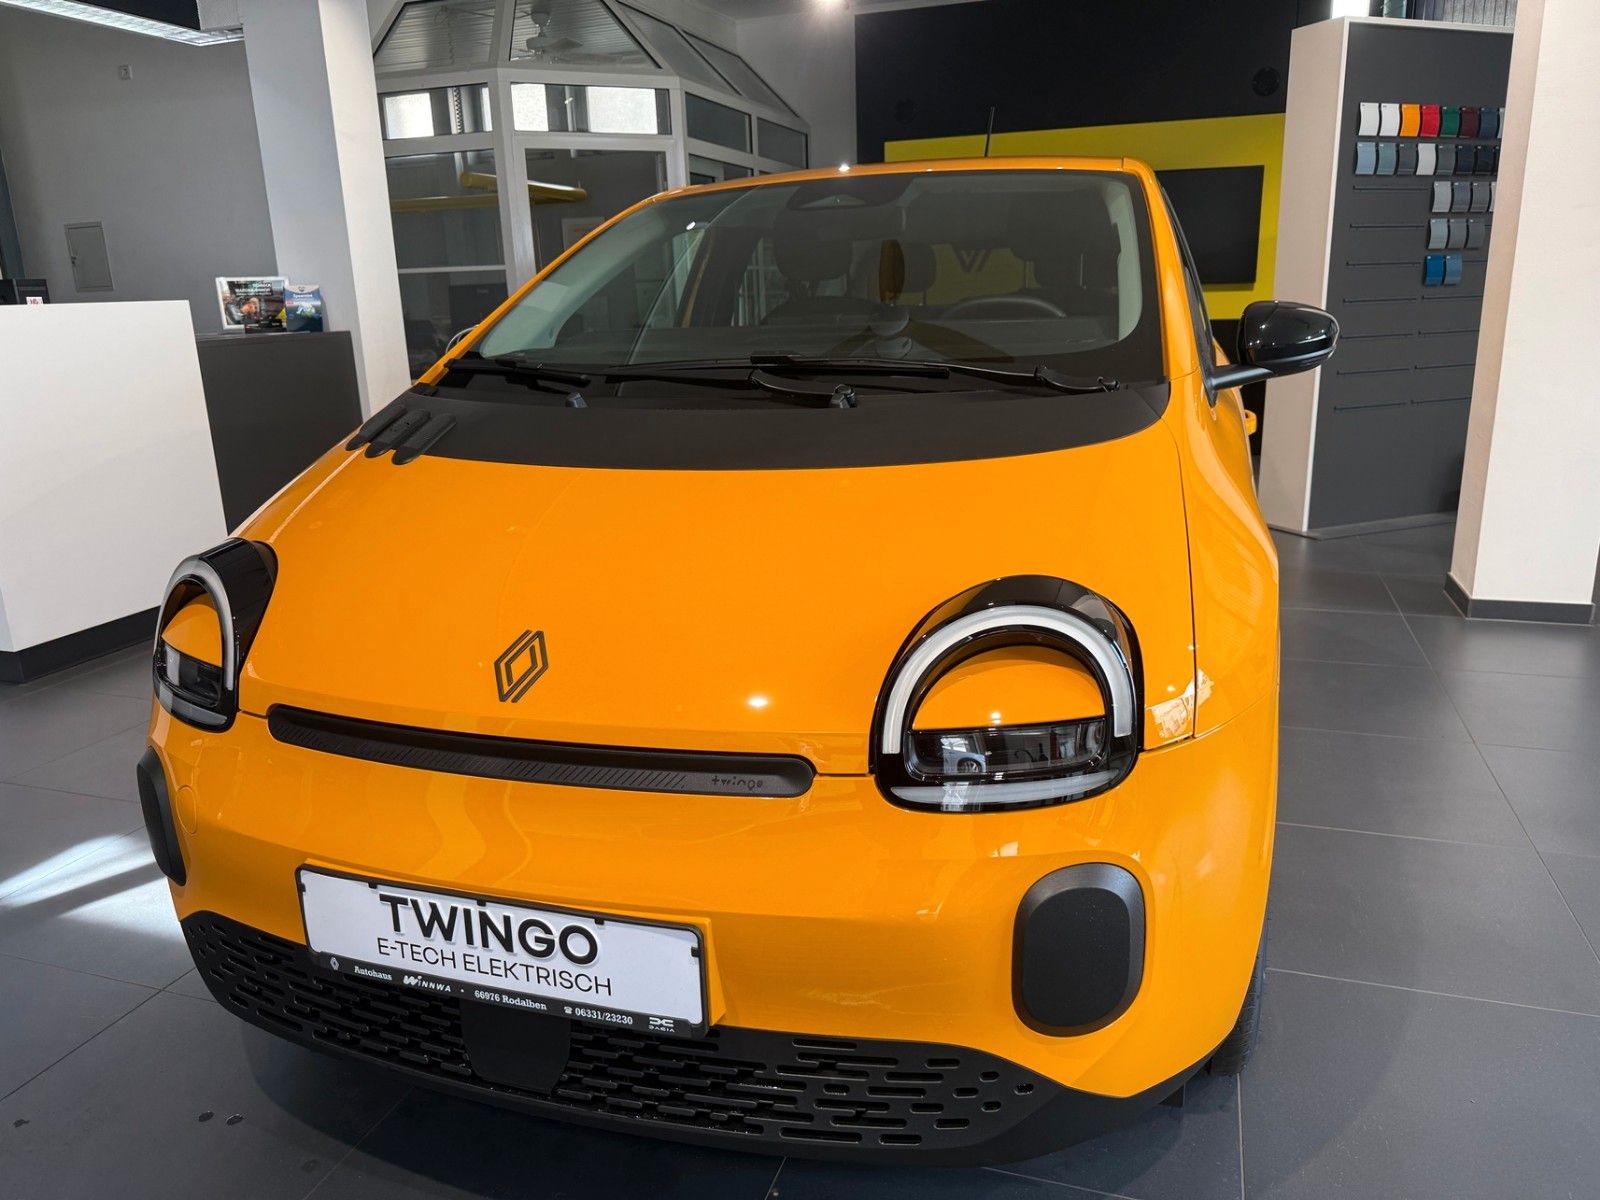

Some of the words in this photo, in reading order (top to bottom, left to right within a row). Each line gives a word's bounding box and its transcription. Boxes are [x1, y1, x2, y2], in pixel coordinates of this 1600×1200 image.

[711, 775, 763, 791] twingo
[379, 893, 598, 965] TWINGO
[354, 965, 393, 981] Autohaus
[474, 989, 501, 1002] 66976
[502, 994, 548, 1011] Rodalben
[574, 1007, 634, 1025] 06331/23230
[377, 937, 457, 969] E-TECH
[463, 953, 612, 996] ELEKTRISCH
